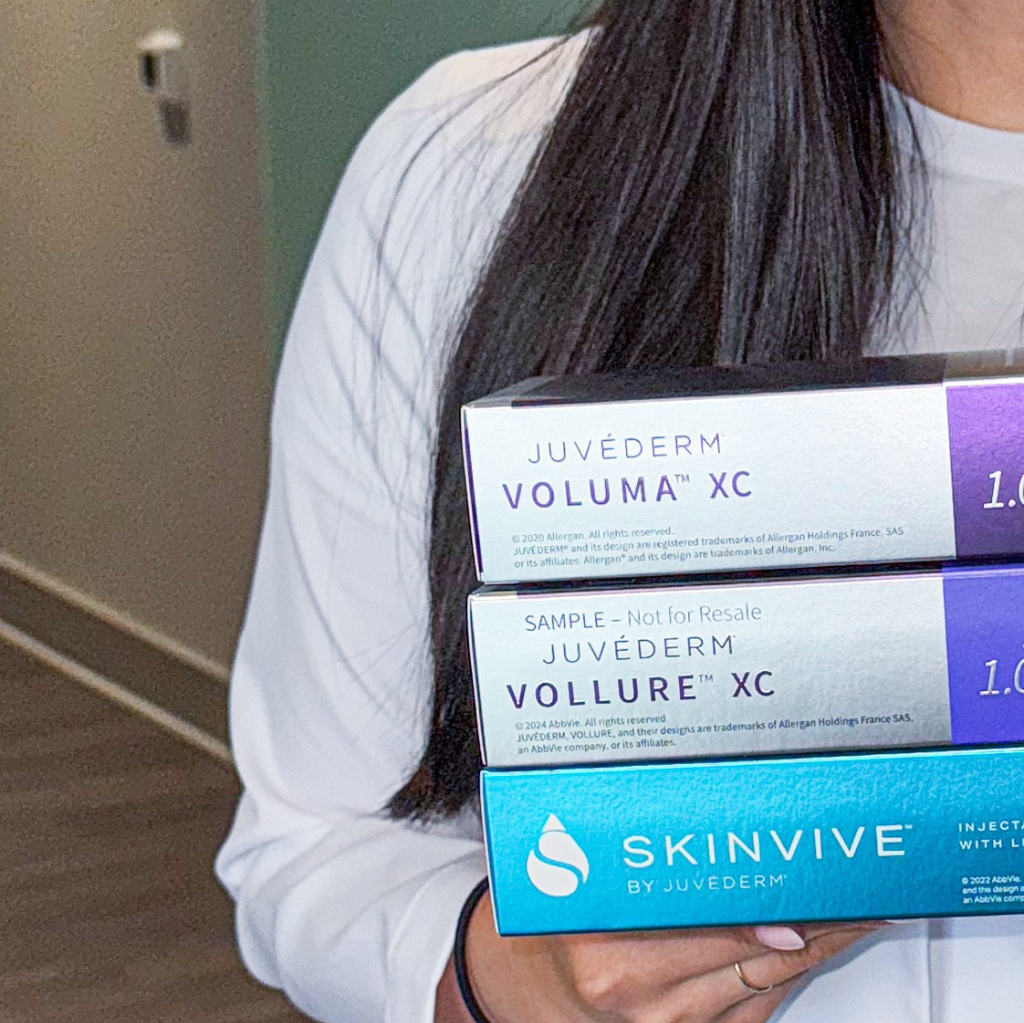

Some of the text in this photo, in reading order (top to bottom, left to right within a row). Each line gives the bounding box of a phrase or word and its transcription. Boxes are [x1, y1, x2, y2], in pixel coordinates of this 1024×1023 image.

[709, 471, 752, 499] XC
[522, 533, 544, 543] 2020
[589, 530, 600, 539] All
[603, 528, 629, 539] rights
[571, 540, 588, 553] and
[590, 541, 601, 552] its
[603, 539, 634, 552] design
[636, 541, 651, 549] are
[653, 537, 699, 550] registered
[701, 535, 754, 546] trademarks
[756, 533, 766, 543] of
[767, 532, 805, 543] Allergan
[807, 530, 849, 542] Holdings
[527, 558, 538, 567] its
[628, 553, 646, 563] and
[648, 552, 659, 561] its
[661, 549, 691, 562] design
[694, 551, 708, 559] are
[710, 547, 763, 558] trademarks
[765, 545, 775, 555] of
[776, 545, 817, 555] Allergan,
[819, 543, 836, 552] Inc.
[525, 611, 606, 633] SAMPLE
[628, 609, 663, 627] Not
[668, 605, 694, 626] for
[699, 603, 762, 624] Resale
[731, 670, 775, 698] XC
[517, 731, 569, 743] JUVÉDERM,
[570, 729, 615, 740] VOLLURE,
[617, 727, 635, 737] and
[637, 726, 658, 736] their
[660, 725, 695, 736] designs
[713, 722, 766, 732] trademarks
[767, 720, 777, 729] of
[779, 719, 816, 730] Allergan
[818, 717, 859, 728] Holdings
[861, 715, 891, 725] France
[524, 720, 546, 730] 2024
[585, 718, 596, 727] All
[599, 716, 625, 728] rights
[531, 744, 562, 754] AbbVie
[564, 742, 609, 753] company,
[622, 740, 633, 749] its
[635, 738, 676, 748] affiliates.
[959, 839, 1002, 850] WITH
[628, 880, 653, 895] BY
[978, 885, 991, 894] the
[993, 884, 1019, 895] design
[974, 895, 1002, 904] AbbVie
